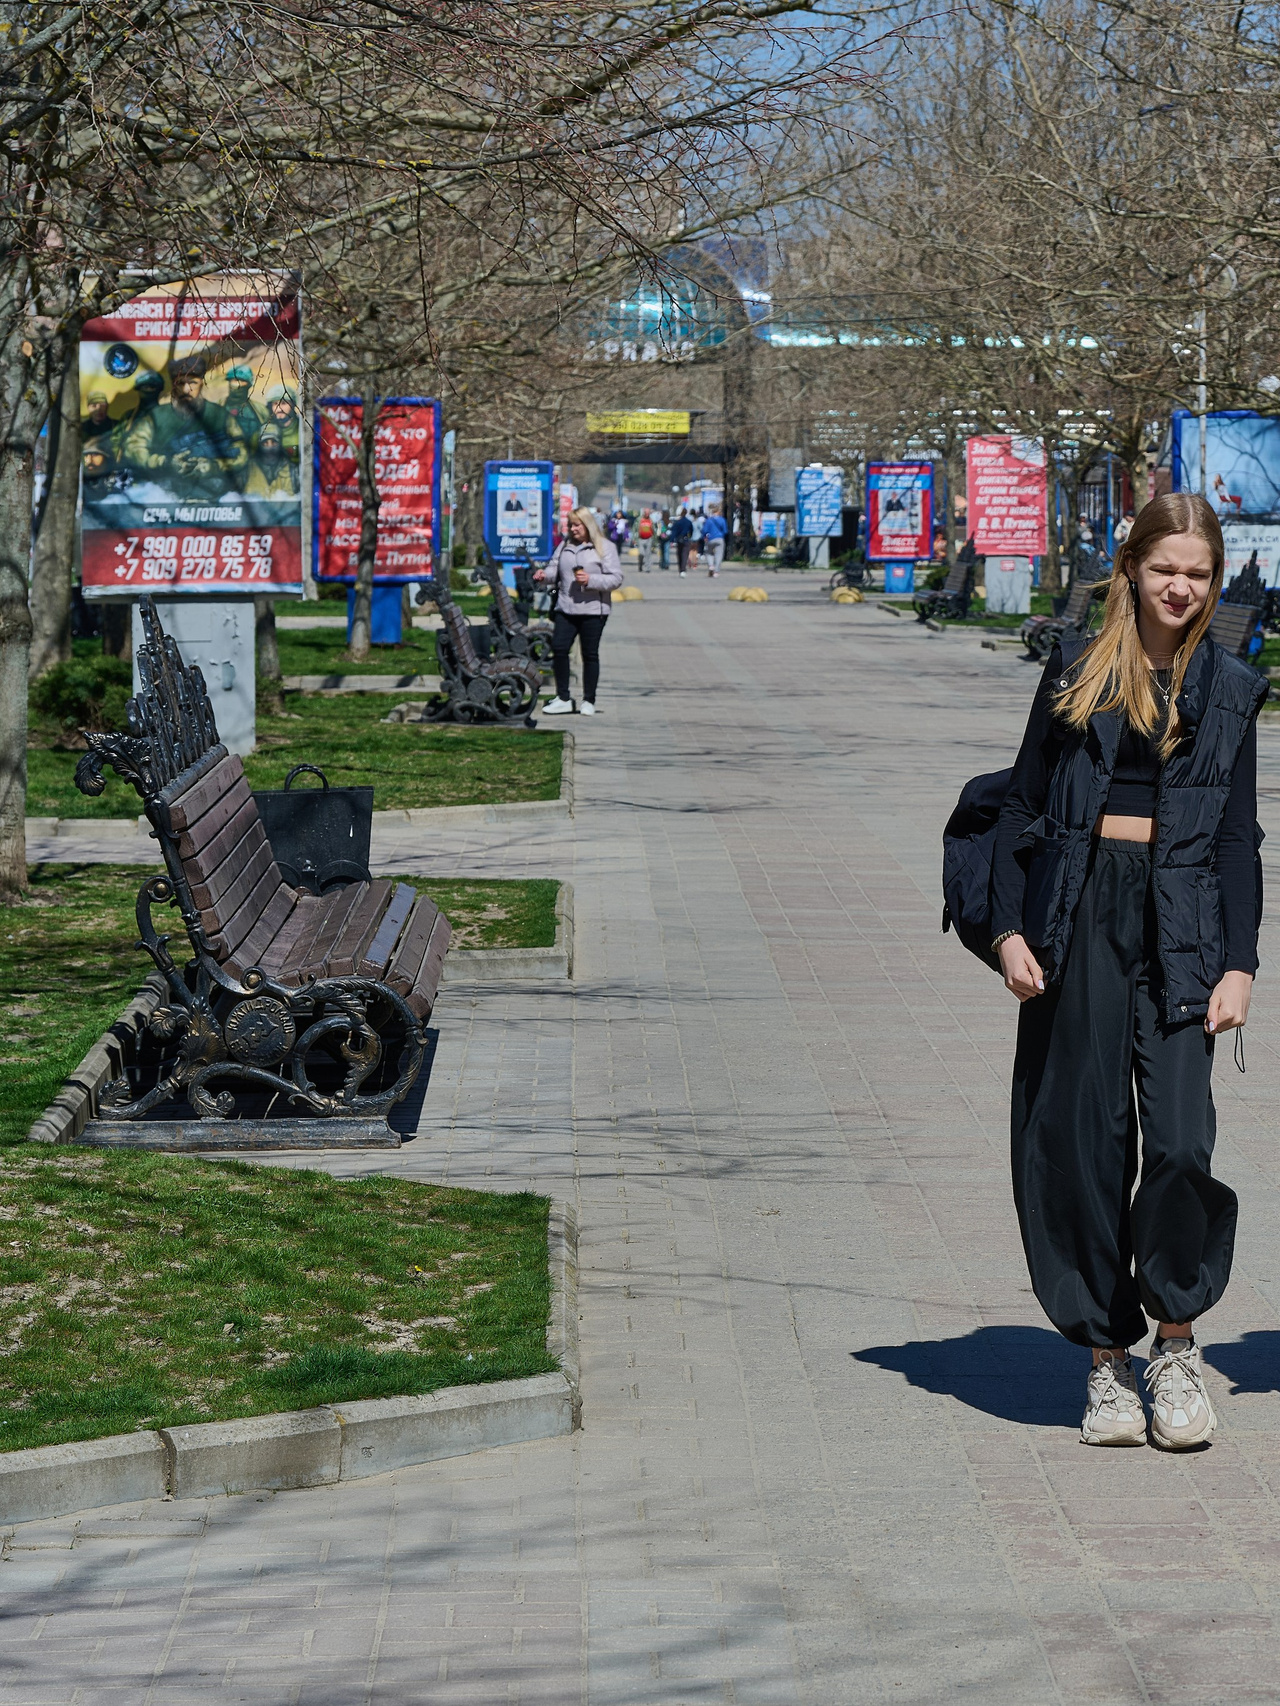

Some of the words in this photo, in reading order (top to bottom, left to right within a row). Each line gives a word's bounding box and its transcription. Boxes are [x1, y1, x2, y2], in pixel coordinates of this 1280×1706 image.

[102, 300, 164, 319] ИВАЙСЯ
[165, 303, 174, 318] В
[135, 321, 191, 337] БРИГАДЫ
[335, 424, 396, 442] ЗНМ,
[400, 428, 427, 440] ЧТО
[330, 444, 355, 460] НА
[336, 498, 400, 509] ТЕРРИЙ
[143, 508, 171, 524] СЕЧЬ,
[174, 507, 196, 522] МЫ
[335, 518, 357, 530] МЫ
[114, 537, 139, 559] +7
[142, 536, 178, 558] 990
[180, 536, 217, 558] 000
[219, 535, 246, 557] 85
[247, 534, 273, 557] 59
[326, 533, 428, 547] РАССТЫВАТЬ
[114, 558, 139, 580] +7
[142, 558, 178, 580] 909
[180, 558, 217, 579] 278
[220, 557, 246, 579] 75
[248, 557, 273, 579] 78
